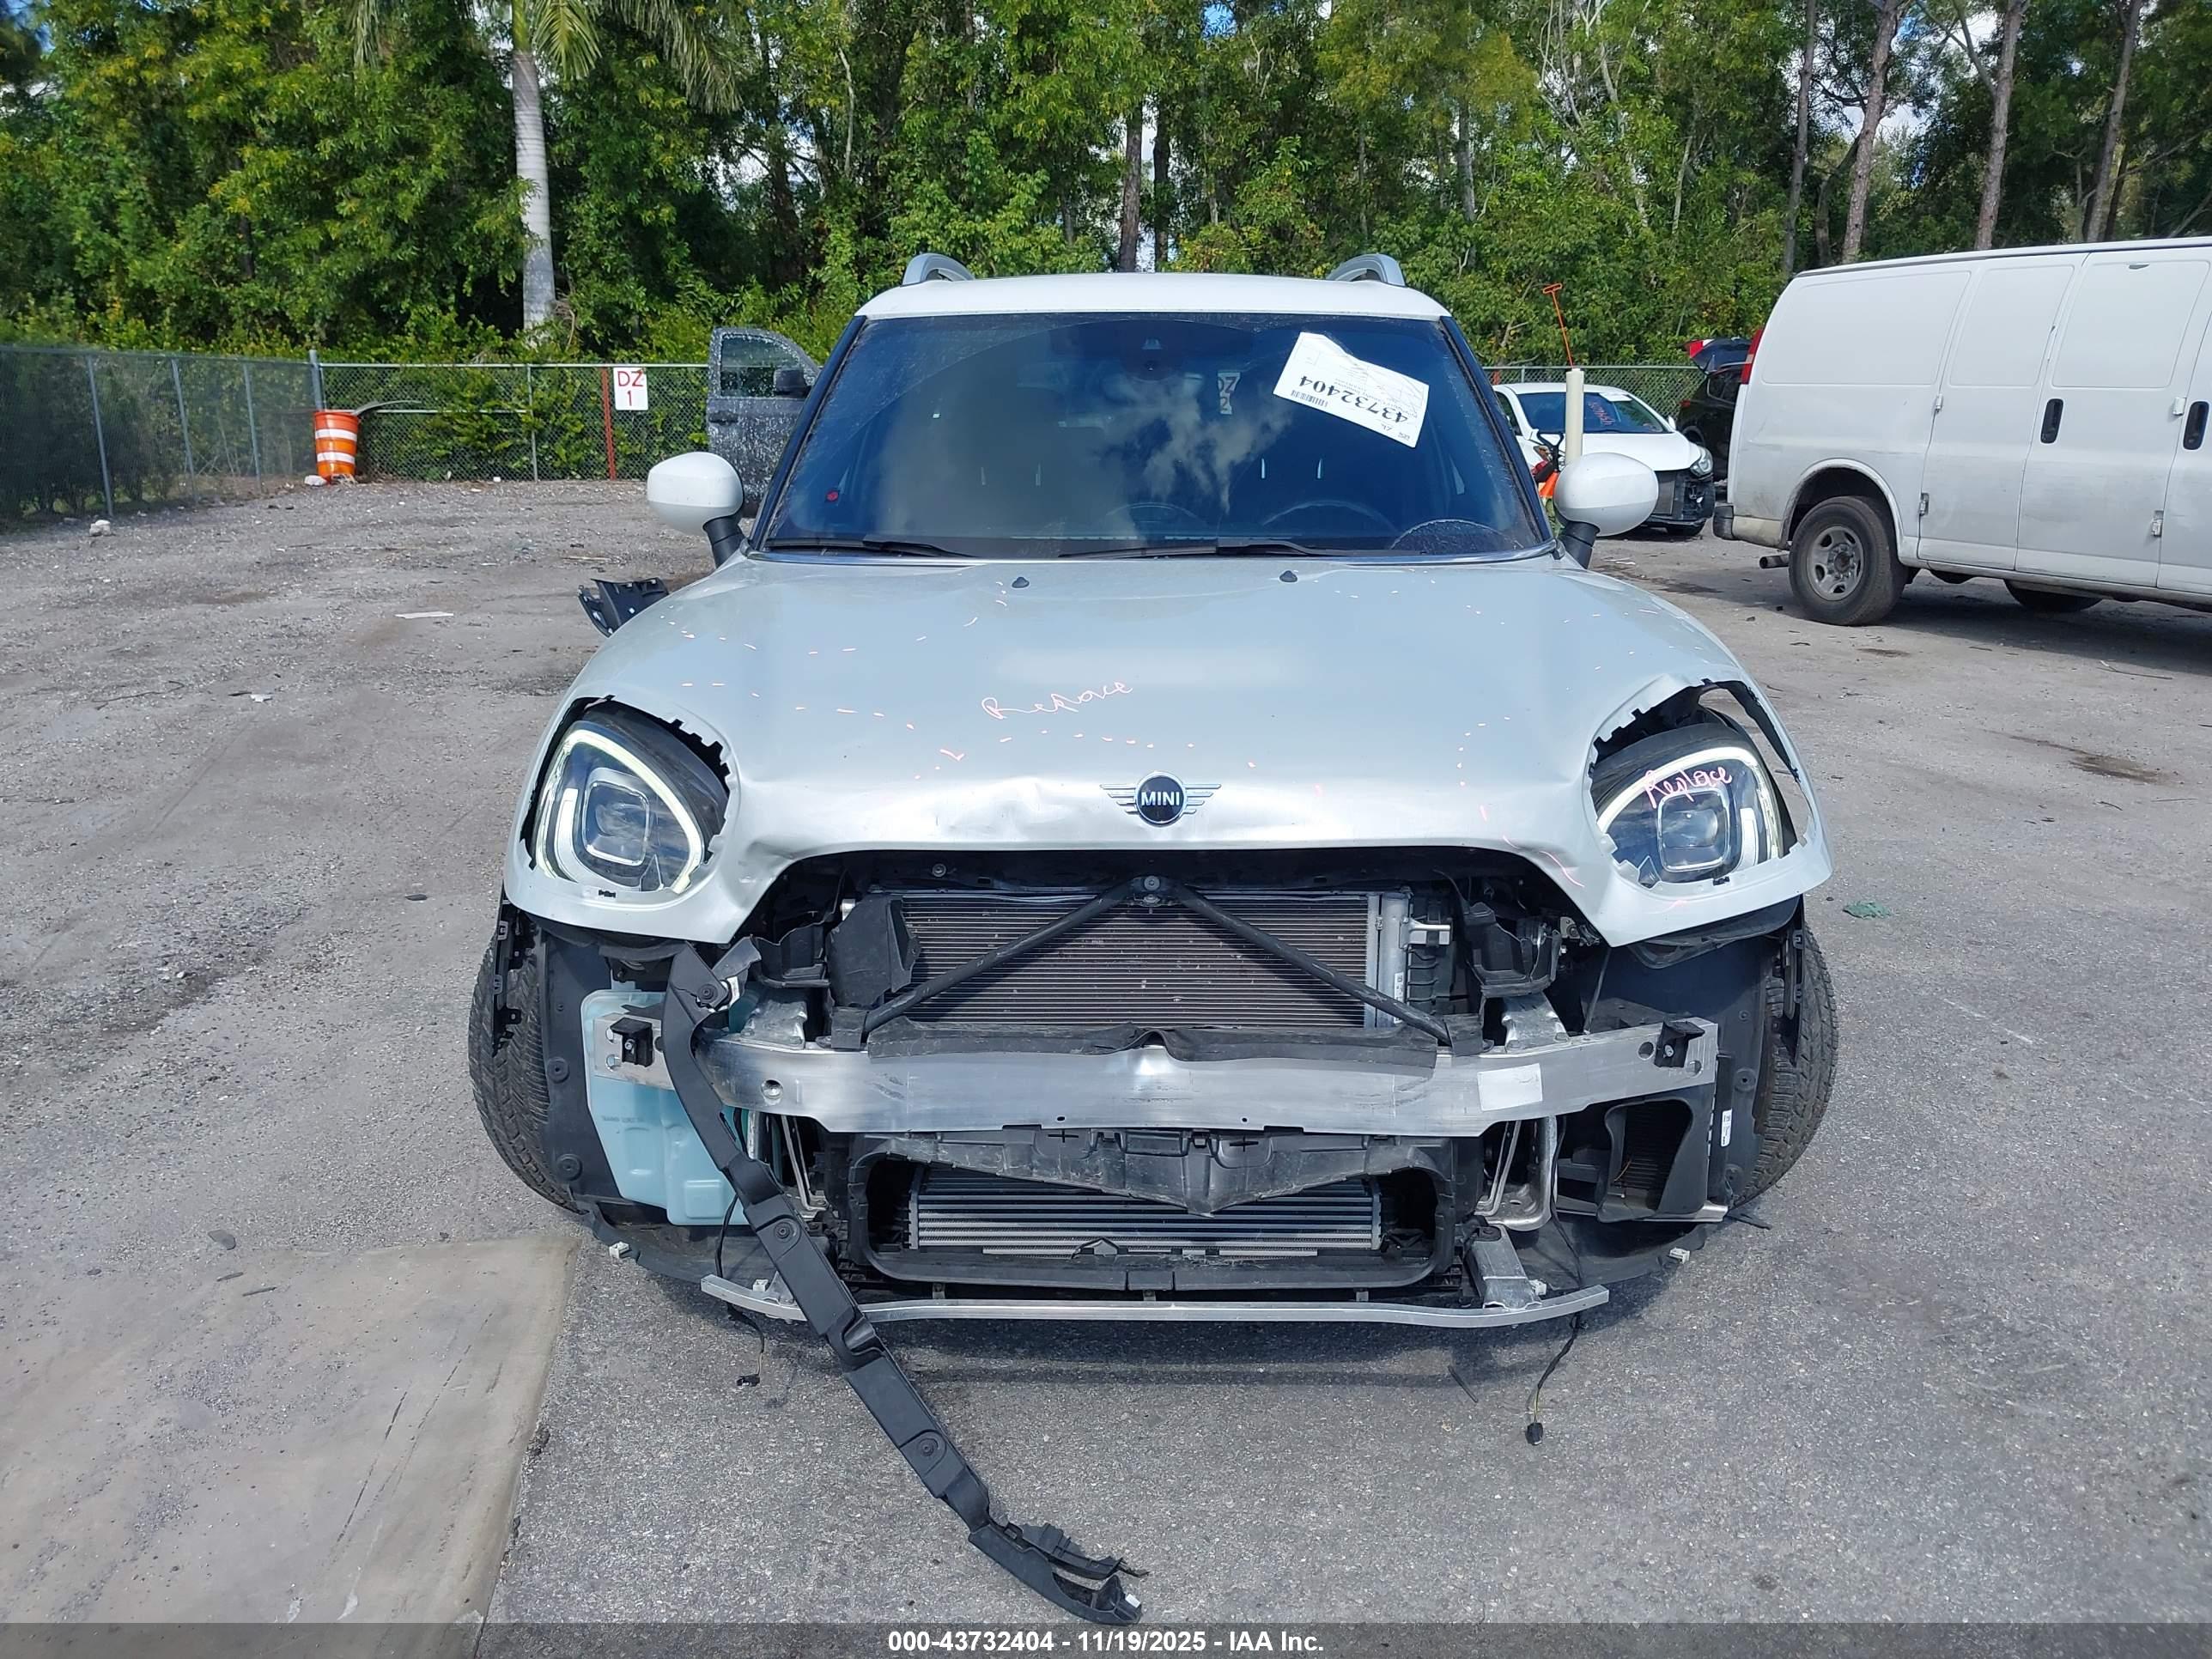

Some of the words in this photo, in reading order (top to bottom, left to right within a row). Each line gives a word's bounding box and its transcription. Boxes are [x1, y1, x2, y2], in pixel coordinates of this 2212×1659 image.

[617, 371, 643, 387] DZ
[627, 390, 632, 407] 1
[1298, 375, 1409, 423] 43732404
[1643, 766, 1733, 809] Replace
[1140, 791, 1180, 806] MINI
